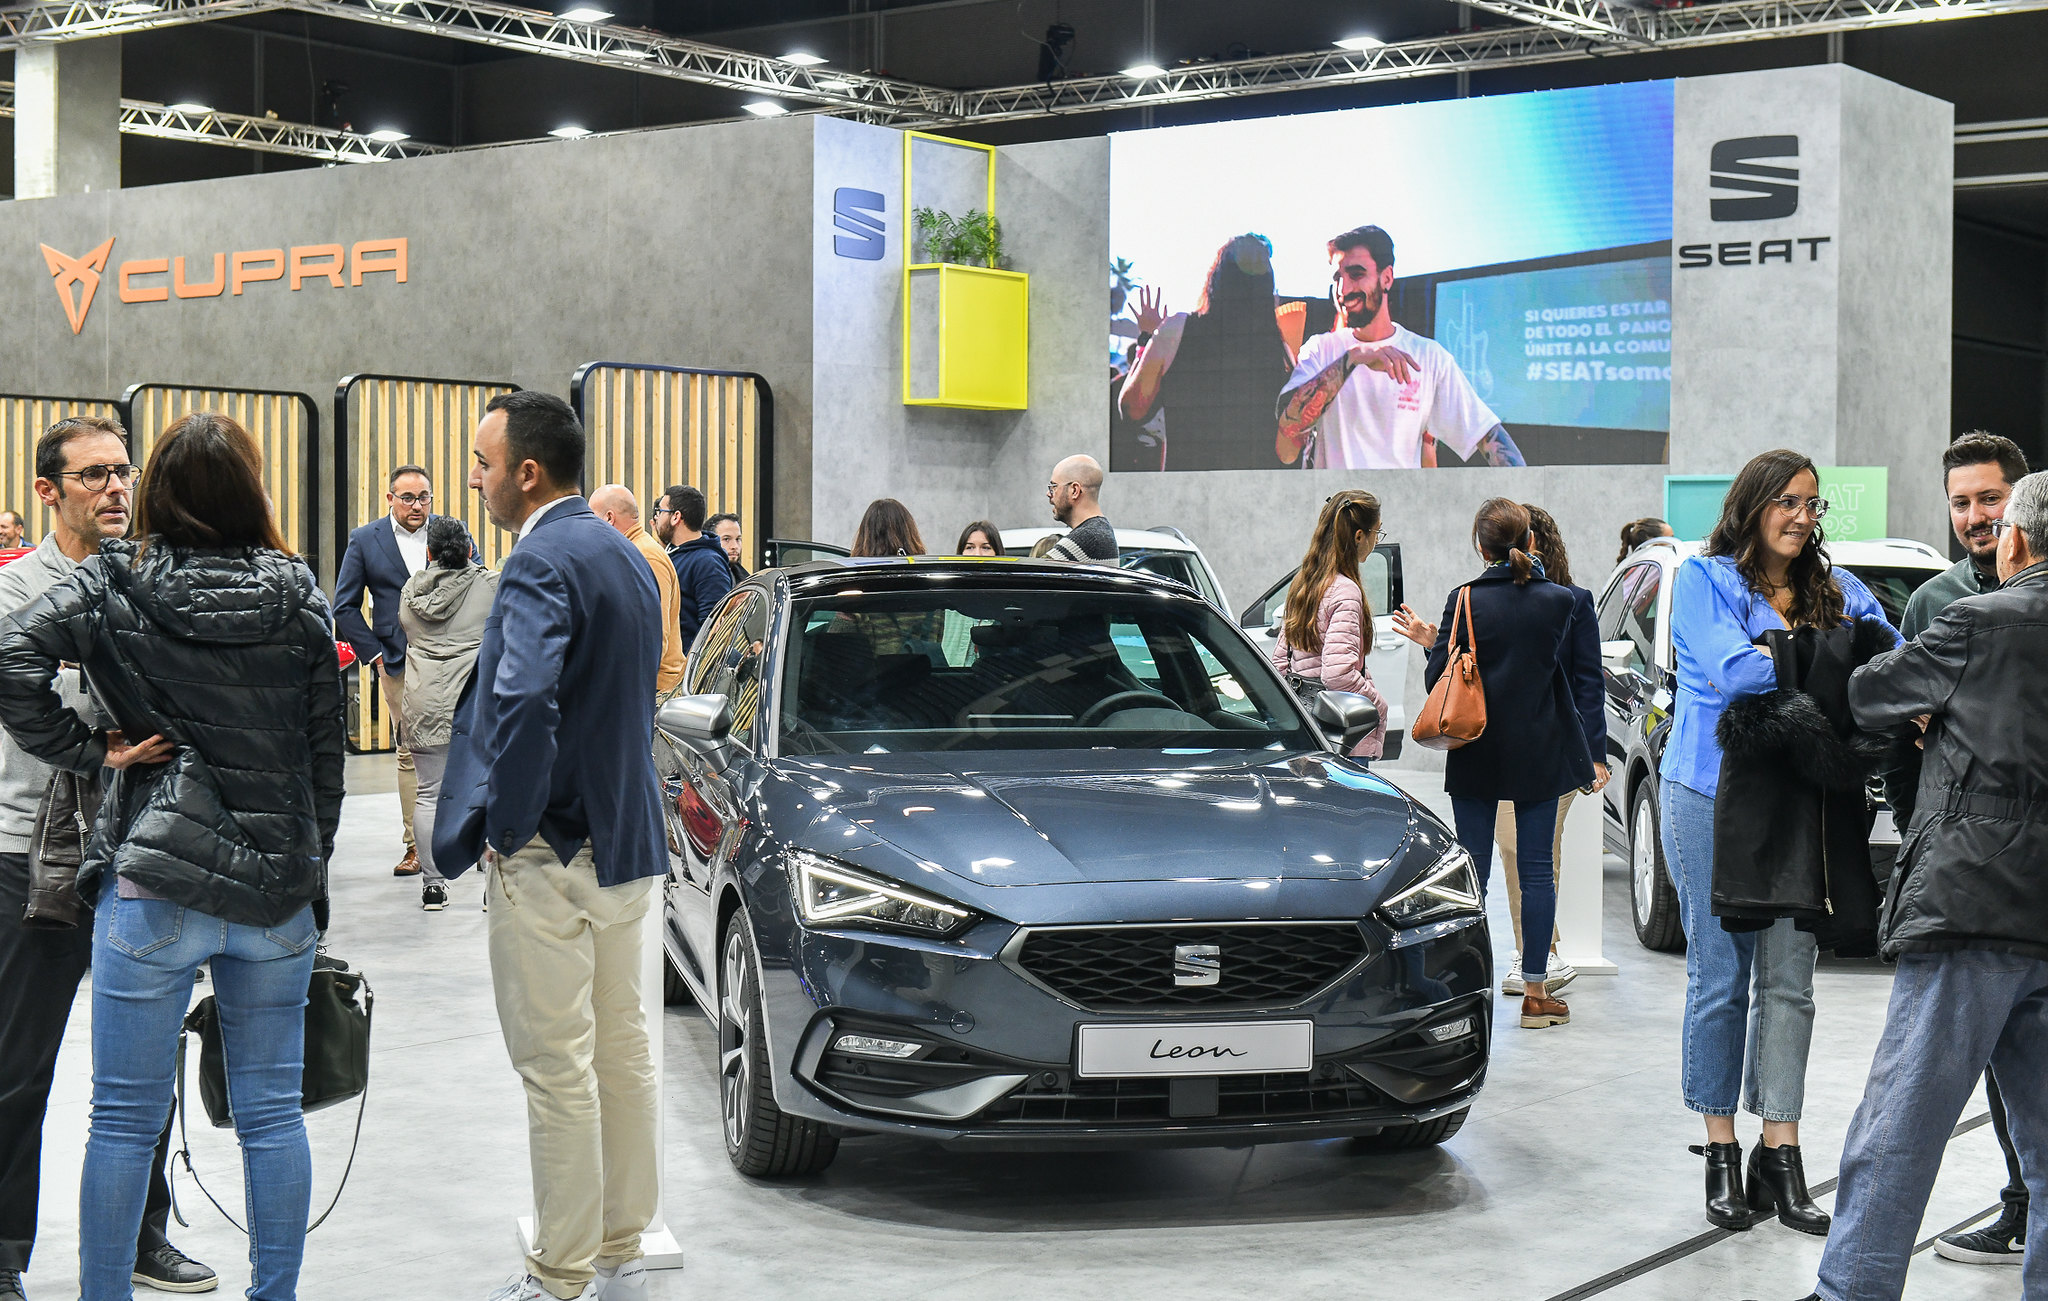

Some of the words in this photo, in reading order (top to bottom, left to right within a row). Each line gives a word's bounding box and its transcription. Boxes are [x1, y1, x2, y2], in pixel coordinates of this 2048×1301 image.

[1679, 236, 1831, 269] SEAT
[119, 237, 408, 304] CUPRA
[1525, 309, 1539, 323] SI
[1541, 305, 1608, 323] QUIERES
[1611, 300, 1668, 317] ESTAR
[1525, 326, 1544, 340] DE
[1546, 323, 1592, 338] TODO
[1595, 322, 1613, 336] EL
[1619, 319, 1671, 335] PANO
[1525, 340, 1572, 357] ÚNETE
[1575, 341, 1587, 355] A
[1590, 341, 1611, 355] LA
[1614, 340, 1671, 354] COMU
[1823, 483, 1865, 511] AT
[1150, 1039, 1248, 1059] Leon
